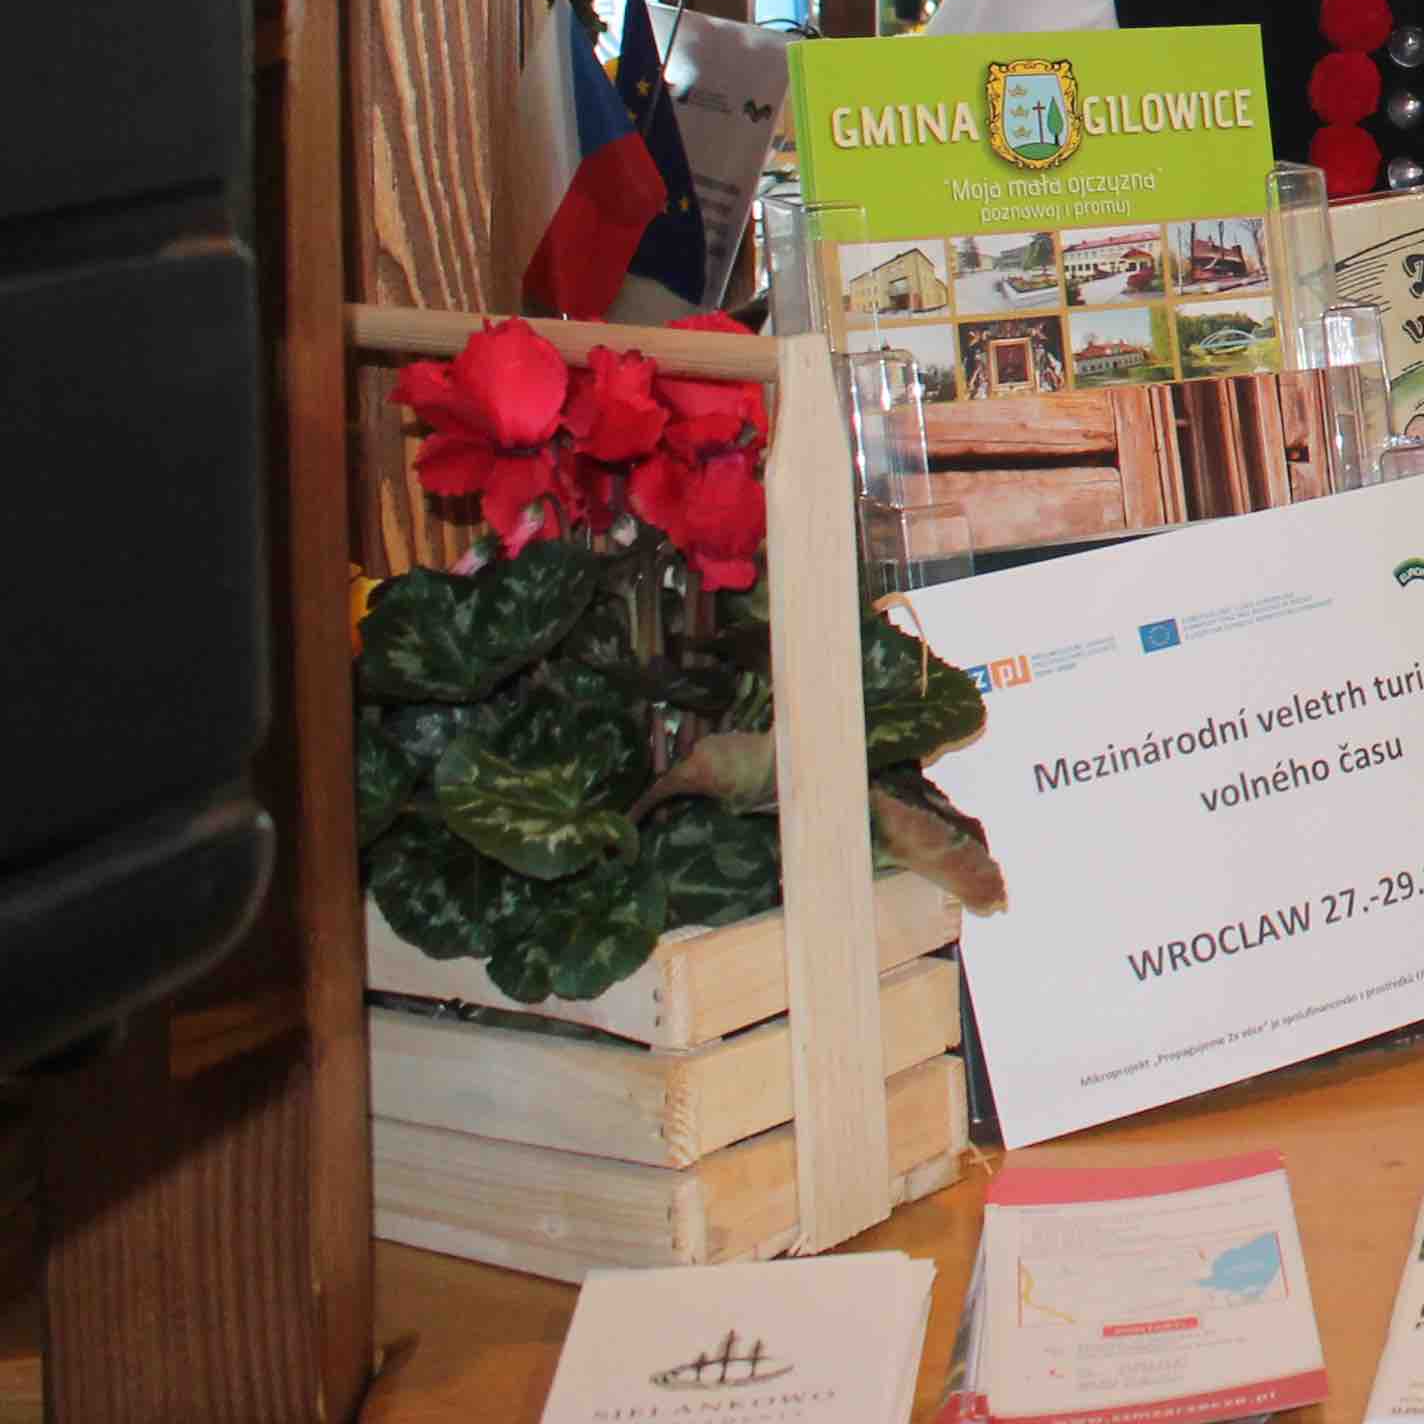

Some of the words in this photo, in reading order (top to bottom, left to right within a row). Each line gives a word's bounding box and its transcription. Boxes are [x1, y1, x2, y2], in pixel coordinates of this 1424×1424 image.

[832, 102, 979, 150] GMINA
[1083, 88, 1255, 136] GILOWICE
[981, 200, 1060, 225] poznawaj
[1075, 197, 1132, 221] promuj
[1007, 175, 1062, 197] mała
[1033, 706, 1250, 792] Mezinárodní
[1257, 681, 1367, 733] veletrh
[1200, 756, 1331, 814] volného
[1338, 734, 1403, 775] času
[1128, 901, 1312, 983] WROCLAW
